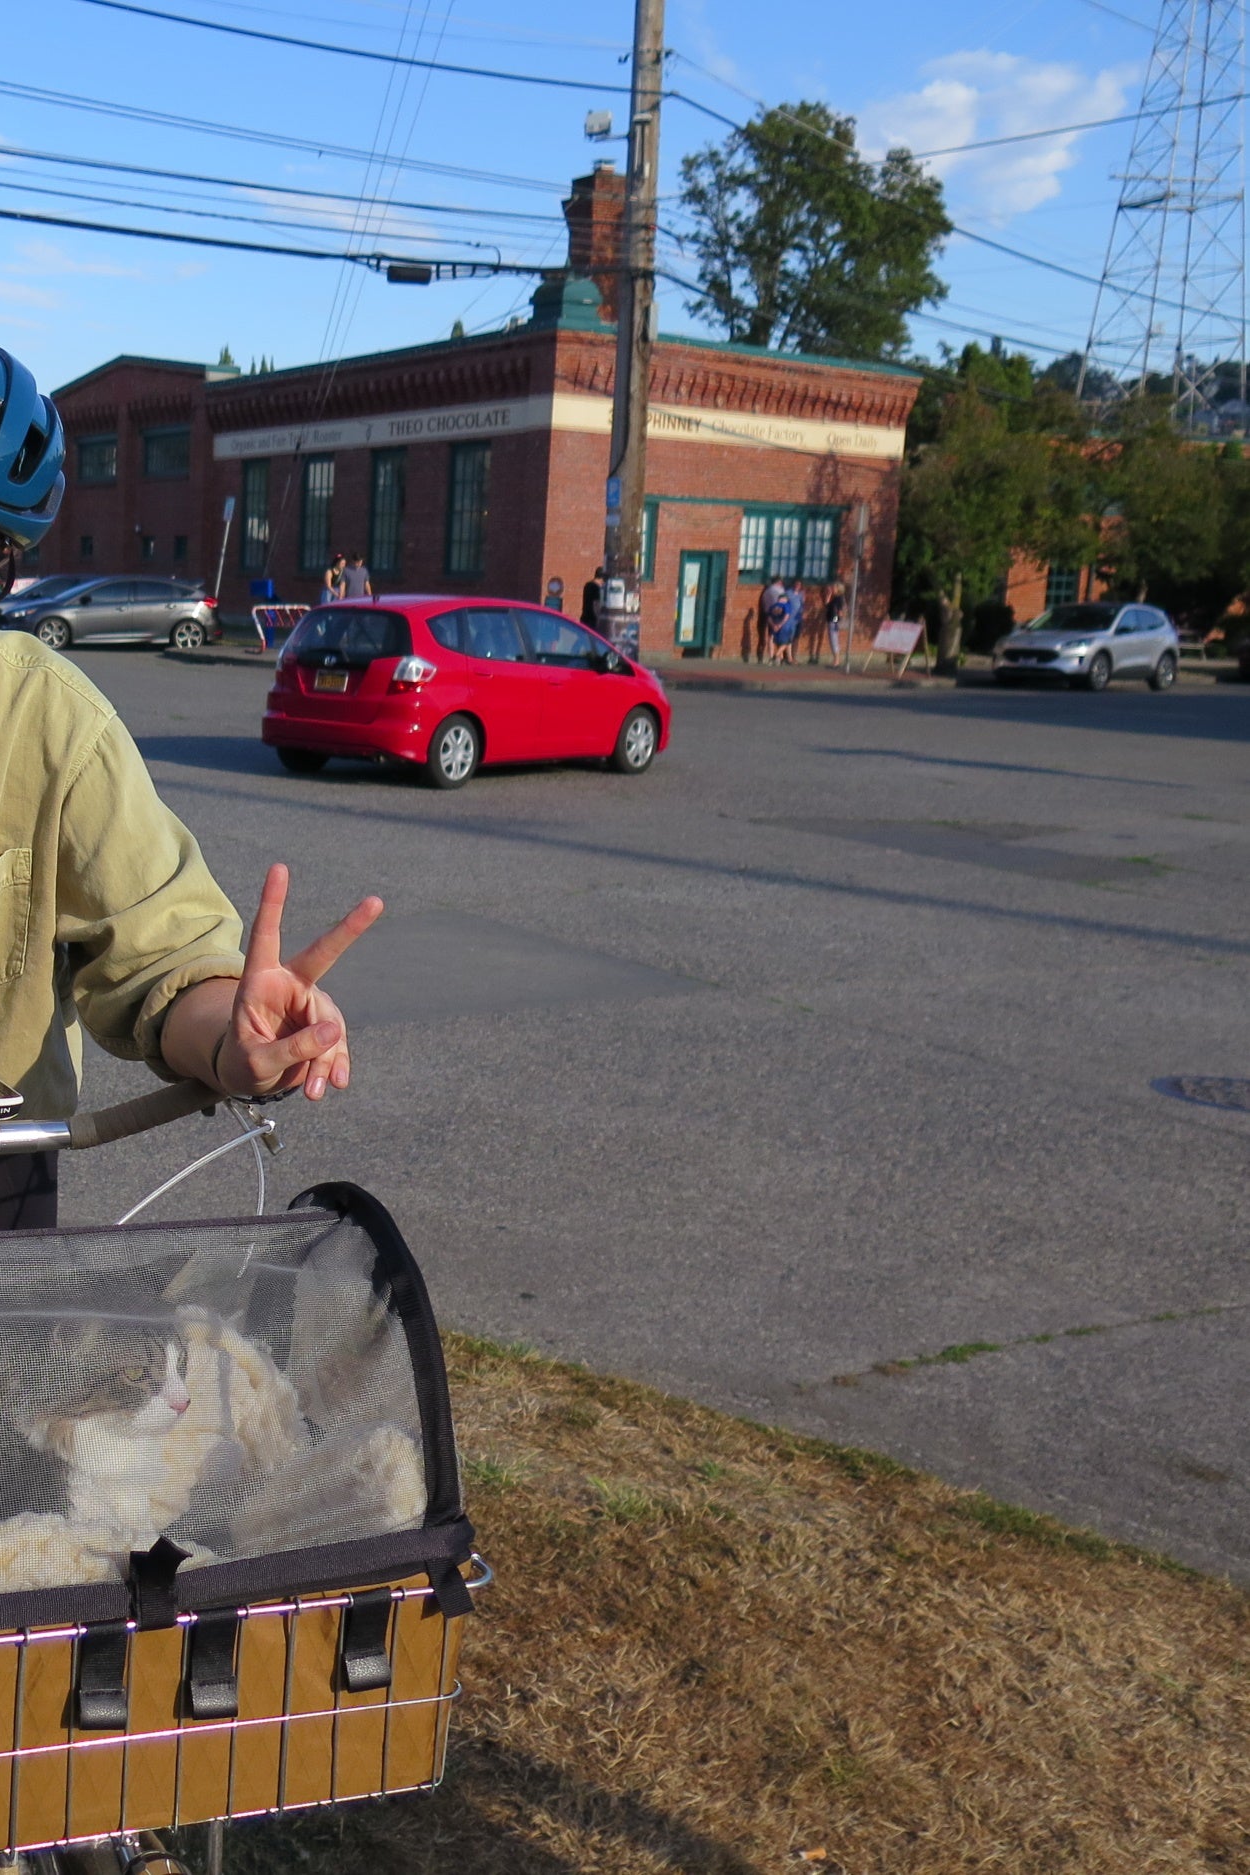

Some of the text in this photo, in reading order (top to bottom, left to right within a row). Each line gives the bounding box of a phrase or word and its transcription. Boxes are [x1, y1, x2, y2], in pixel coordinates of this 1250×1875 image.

[388, 408, 510, 437] THEO CHOCOLATE
[767, 425, 804, 443] Factory
